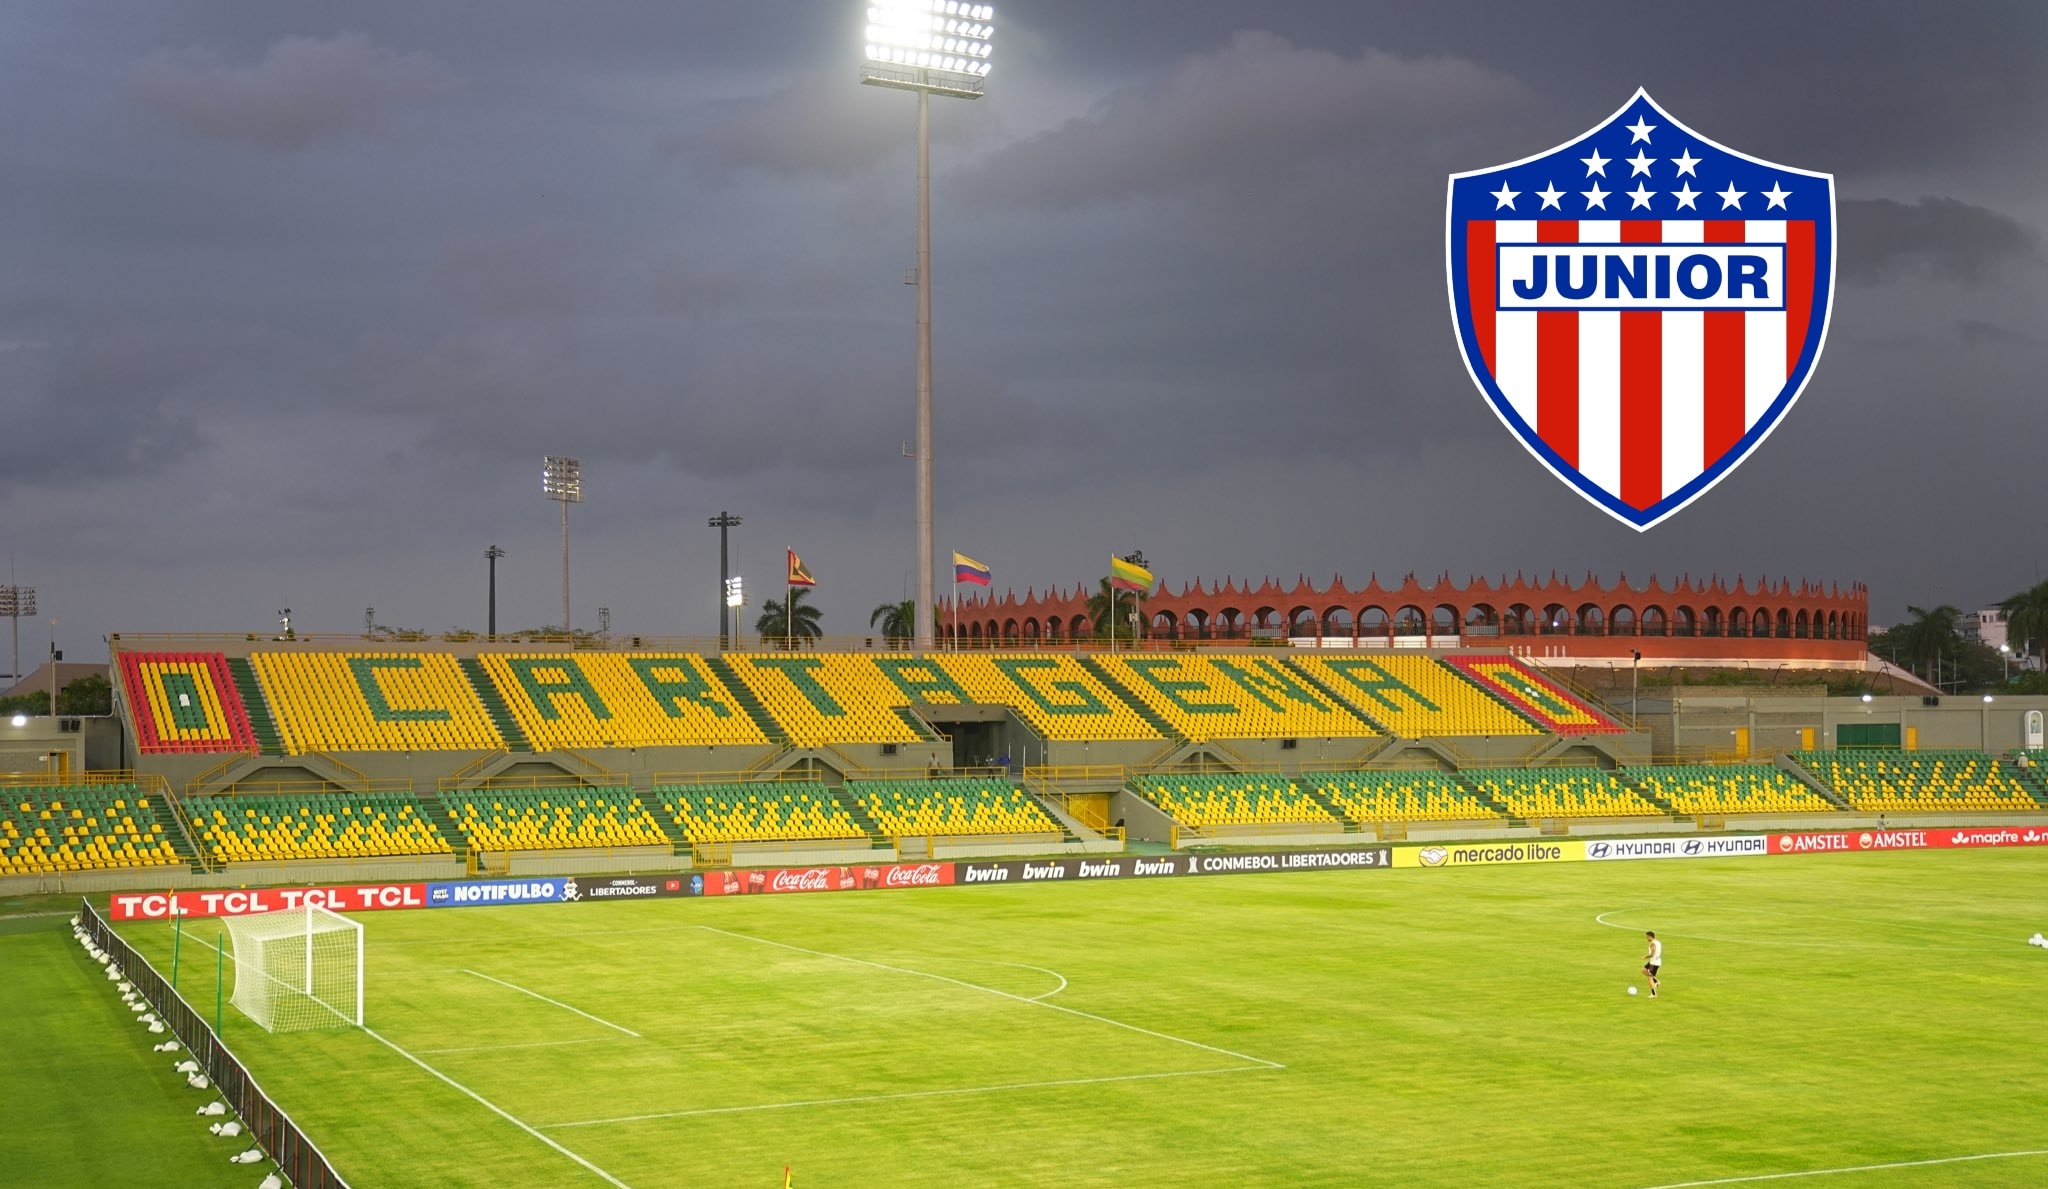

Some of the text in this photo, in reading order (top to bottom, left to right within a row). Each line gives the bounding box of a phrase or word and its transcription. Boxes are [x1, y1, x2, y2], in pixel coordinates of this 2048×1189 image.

[1616, 839, 1765, 855] HYUNDAI HYUNDAI
[1794, 832, 1927, 850] AMSTEL AMSTEL
[1971, 831, 2018, 845] mapfre
[1203, 852, 1374, 871] CONMEBOL LIBERTADORES
[1453, 843, 1561, 863] mercado libre
[773, 869, 829, 890] Coca-Cola
[886, 864, 940, 885] Coca-Cola
[965, 857, 1175, 882] bwin bwin bwin bwin
[454, 883, 555, 901] NOTIFULBO
[590, 886, 657, 896] LIBERTADORES
[118, 886, 420, 917] TCL TCL TCL TCL
